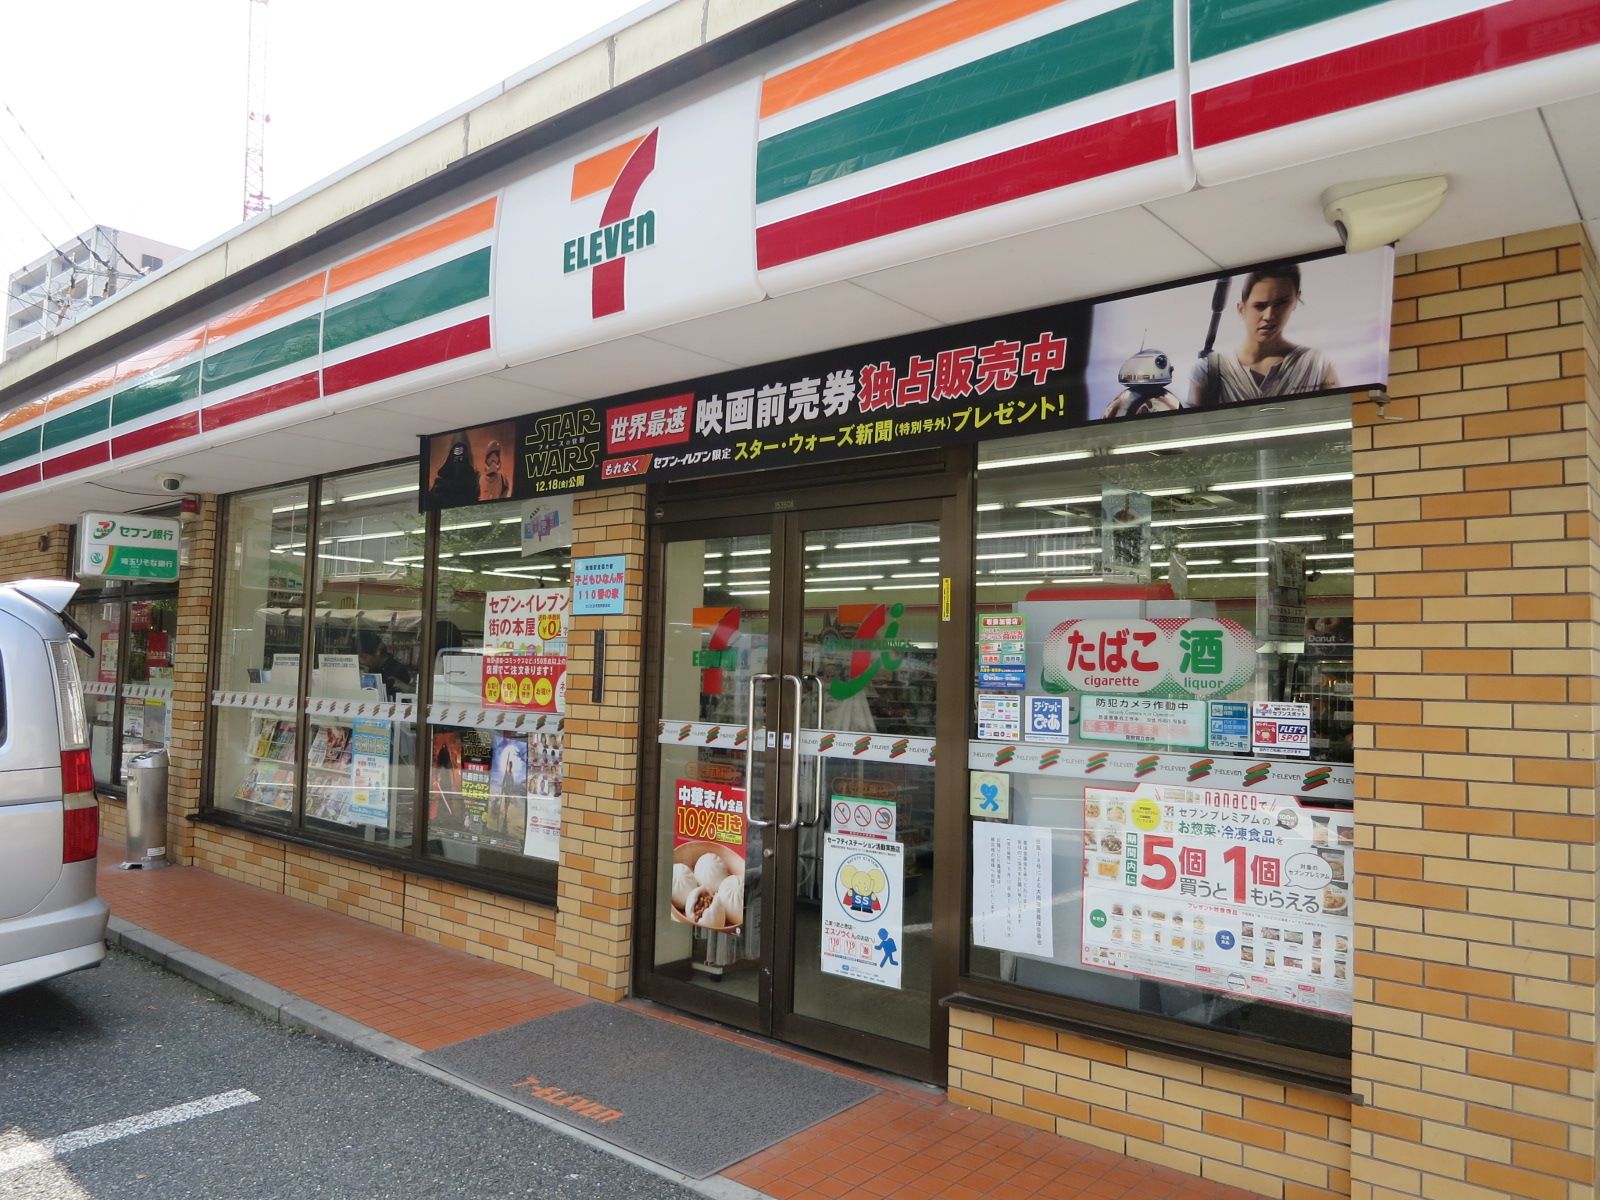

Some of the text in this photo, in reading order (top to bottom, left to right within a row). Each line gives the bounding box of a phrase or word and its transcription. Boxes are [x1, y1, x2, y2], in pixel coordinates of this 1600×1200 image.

[525, 408, 601, 446] STAR
[610, 405, 688, 444] 世界最速
[524, 441, 600, 479] WARS
[604, 459, 639, 476] もれなく
[120, 526, 174, 541] セブン銀行
[488, 616, 536, 637] 街の本屋
[1308, 635, 1336, 643] Donut
[1067, 628, 1159, 673] たばこ
[1179, 629, 1223, 675] 酒
[1084, 674, 1140, 688] cigarette
[1184, 676, 1225, 691] liquor
[1033, 701, 1061, 712] チケット
[1095, 698, 1189, 711] 防犯カメラ作動中
[1033, 713, 1060, 731] ぴあ
[1280, 725, 1306, 734] FLET'S
[1280, 734, 1305, 742] SPOT
[678, 785, 744, 813] 中華まん全品
[677, 806, 743, 840] 10%引き
[1178, 807, 1271, 826] セブンプレミアムの
[1178, 820, 1284, 846] お惣菜・冷凍食品を
[1125, 832, 1138, 887] 期間内に
[1140, 834, 1207, 891] 5個
[1223, 845, 1281, 904] 1個
[1180, 877, 1228, 901] 買うと
[854, 895, 870, 906] SS
[1250, 887, 1320, 914] もらえる
